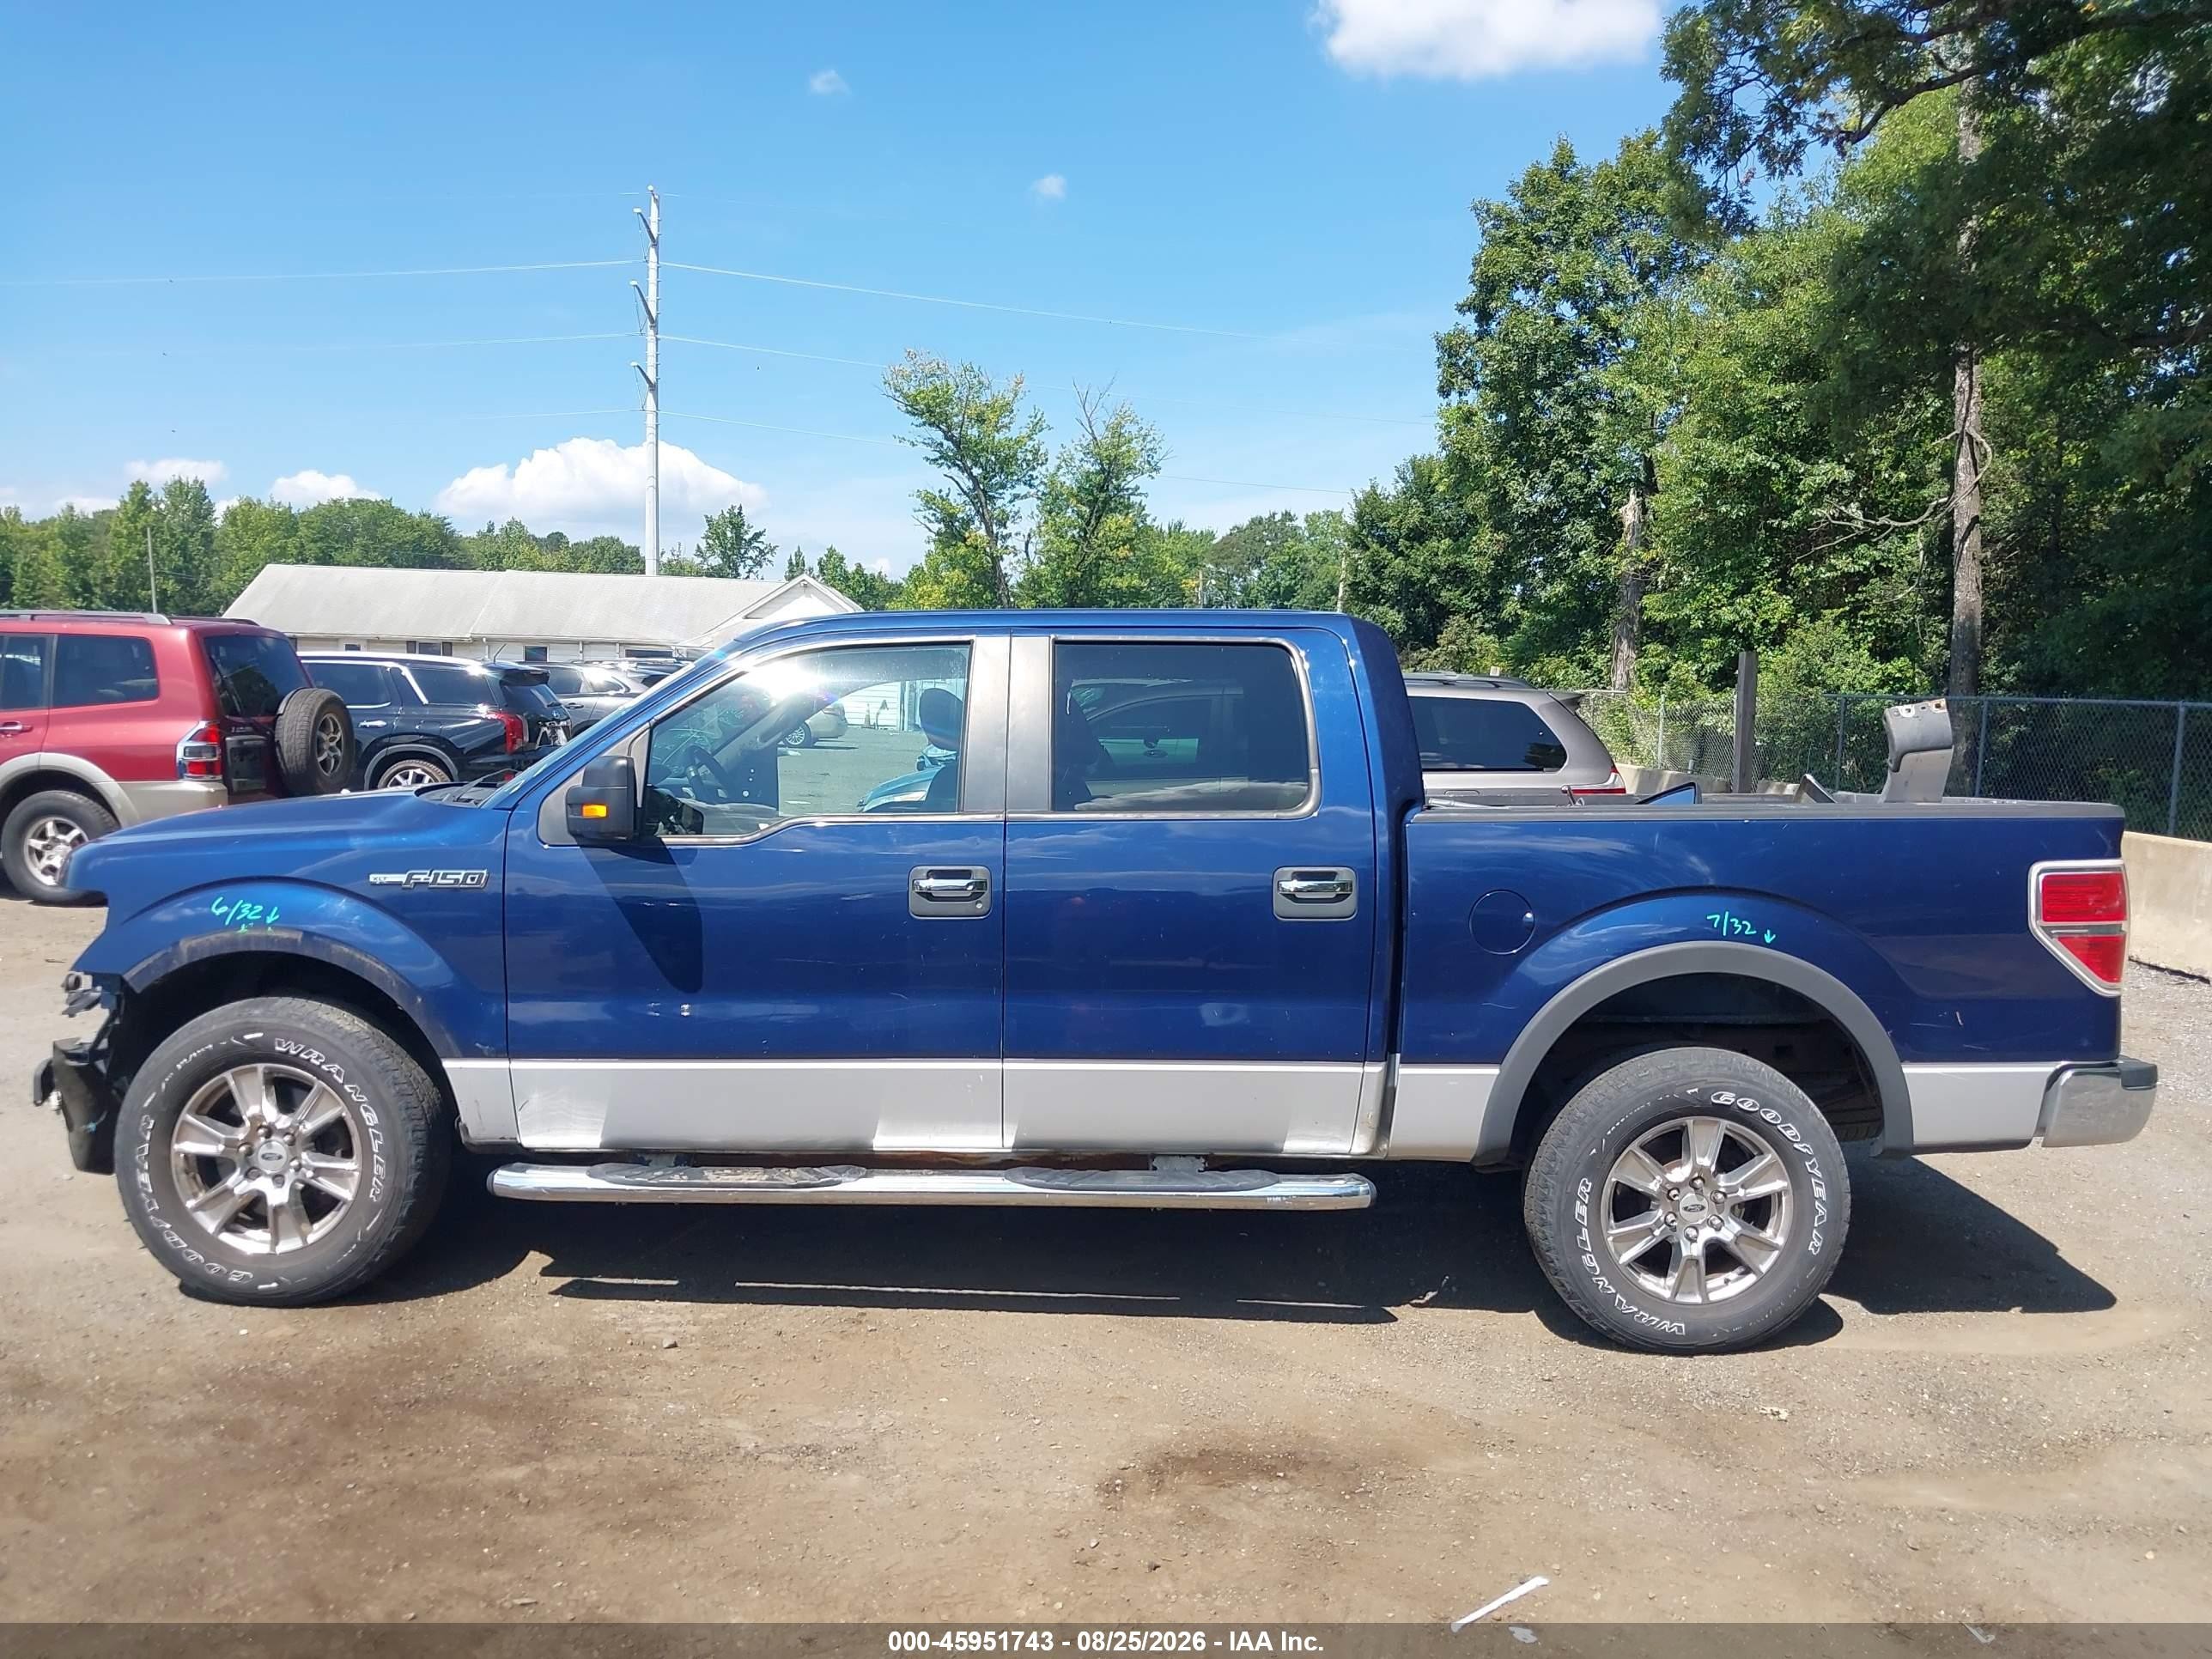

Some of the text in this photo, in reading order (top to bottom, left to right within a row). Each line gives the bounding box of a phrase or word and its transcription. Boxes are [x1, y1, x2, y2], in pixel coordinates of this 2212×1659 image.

[211, 896, 264, 926] 6/32
[402, 870, 487, 889] F-150
[1706, 910, 1757, 936] 7/32
[273, 1037, 386, 1202] WRANGLER
[1711, 1091, 1827, 1256] GOODYEAR
[136, 1115, 254, 1285] GOODYEAR
[1574, 1176, 1686, 1336] WRANGLER
